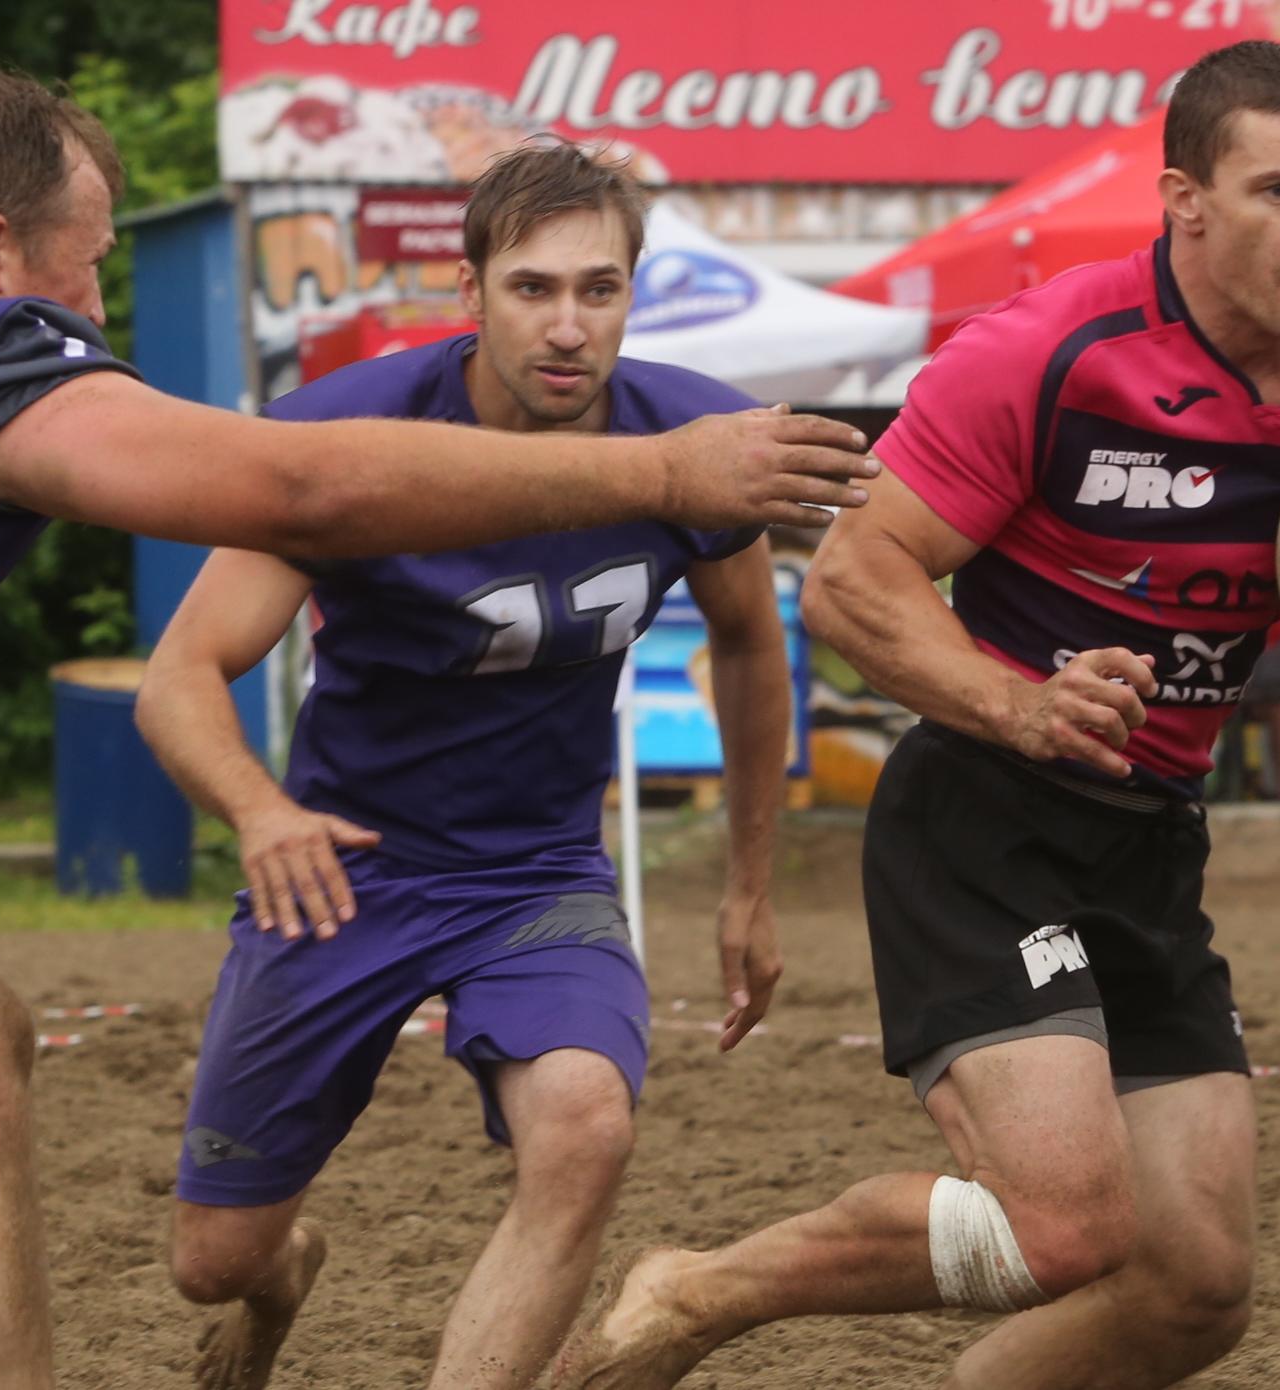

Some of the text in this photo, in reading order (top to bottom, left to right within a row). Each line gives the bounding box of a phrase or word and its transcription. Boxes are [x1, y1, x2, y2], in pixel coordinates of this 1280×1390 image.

[504, 33, 888, 131] Место
[1089, 449, 1168, 466] ENERGY
[1074, 463, 1217, 509] PRO
